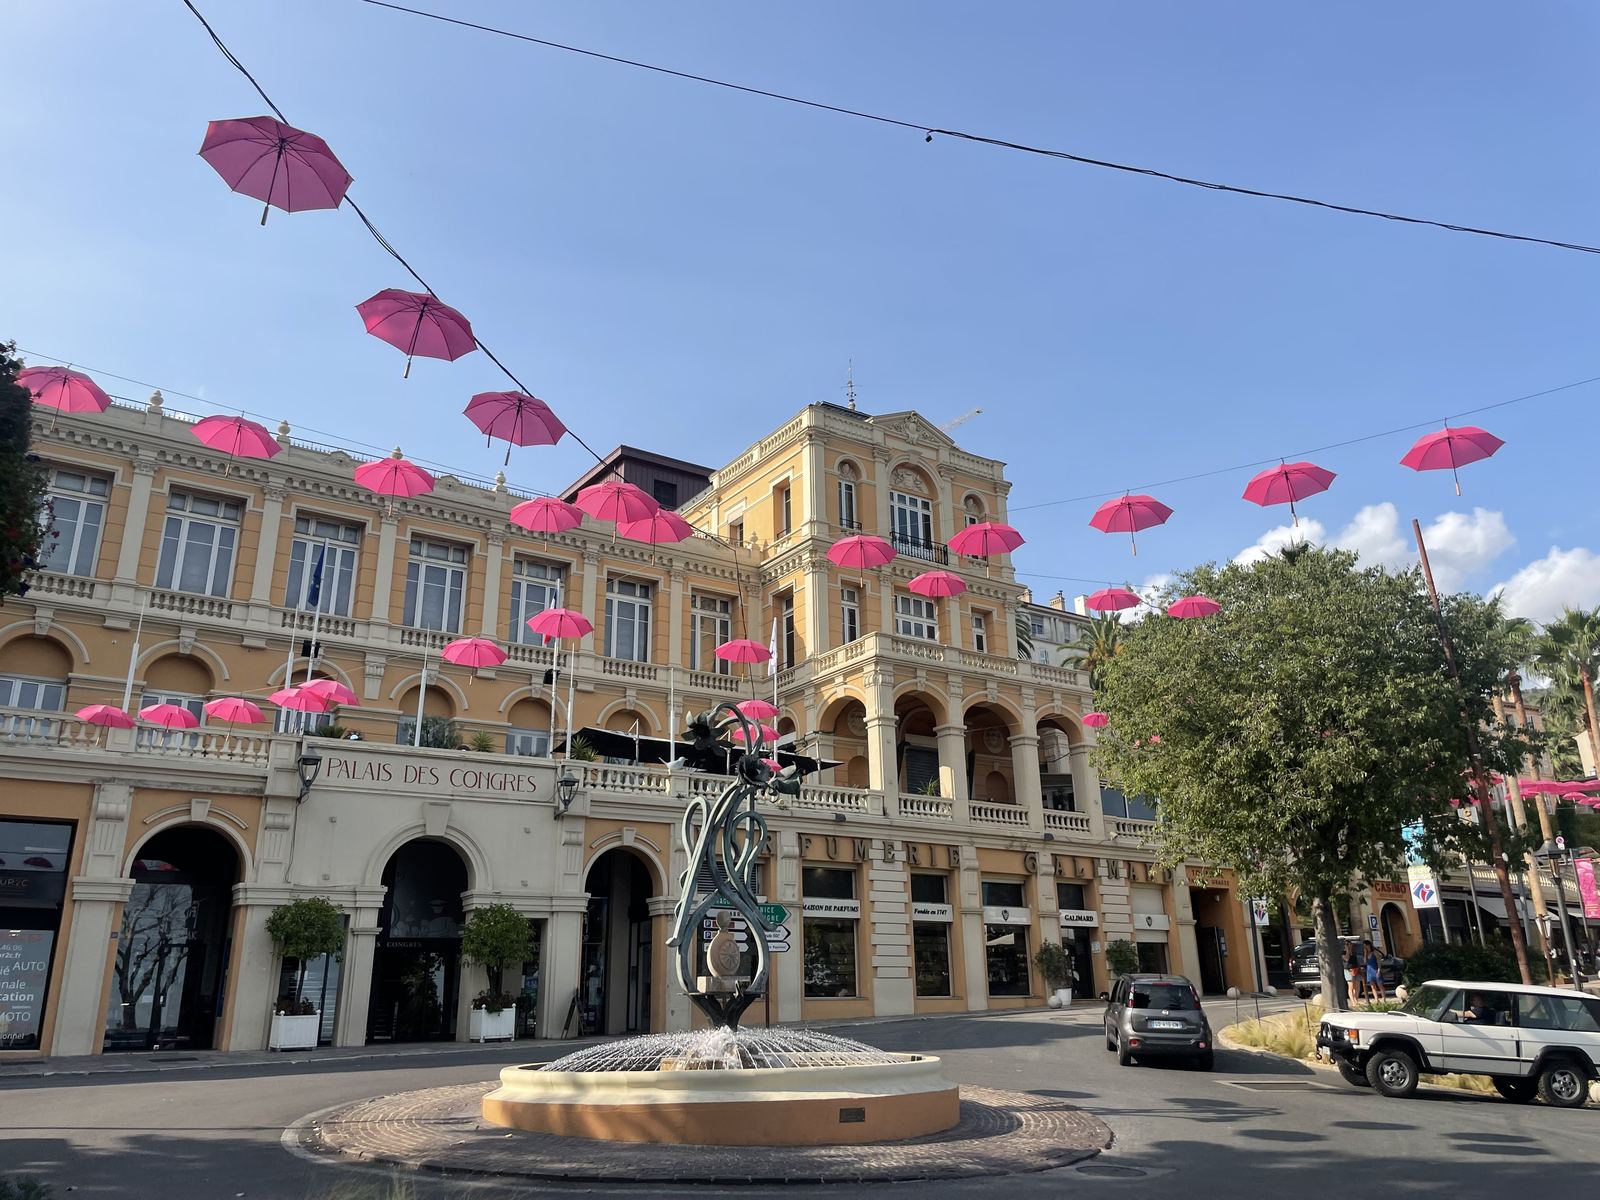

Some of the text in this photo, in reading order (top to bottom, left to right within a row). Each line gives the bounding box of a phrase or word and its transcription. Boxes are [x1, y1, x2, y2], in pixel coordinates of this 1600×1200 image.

[327, 757, 537, 793] PALAIS DES CONGRES
[694, 826, 960, 867] RFUMERIE
[1375, 882, 1407, 894] CASINO
[760, 906, 775, 914] NICE
[1064, 914, 1094, 922] GALIMARD
[12, 961, 46, 971] AUTO
